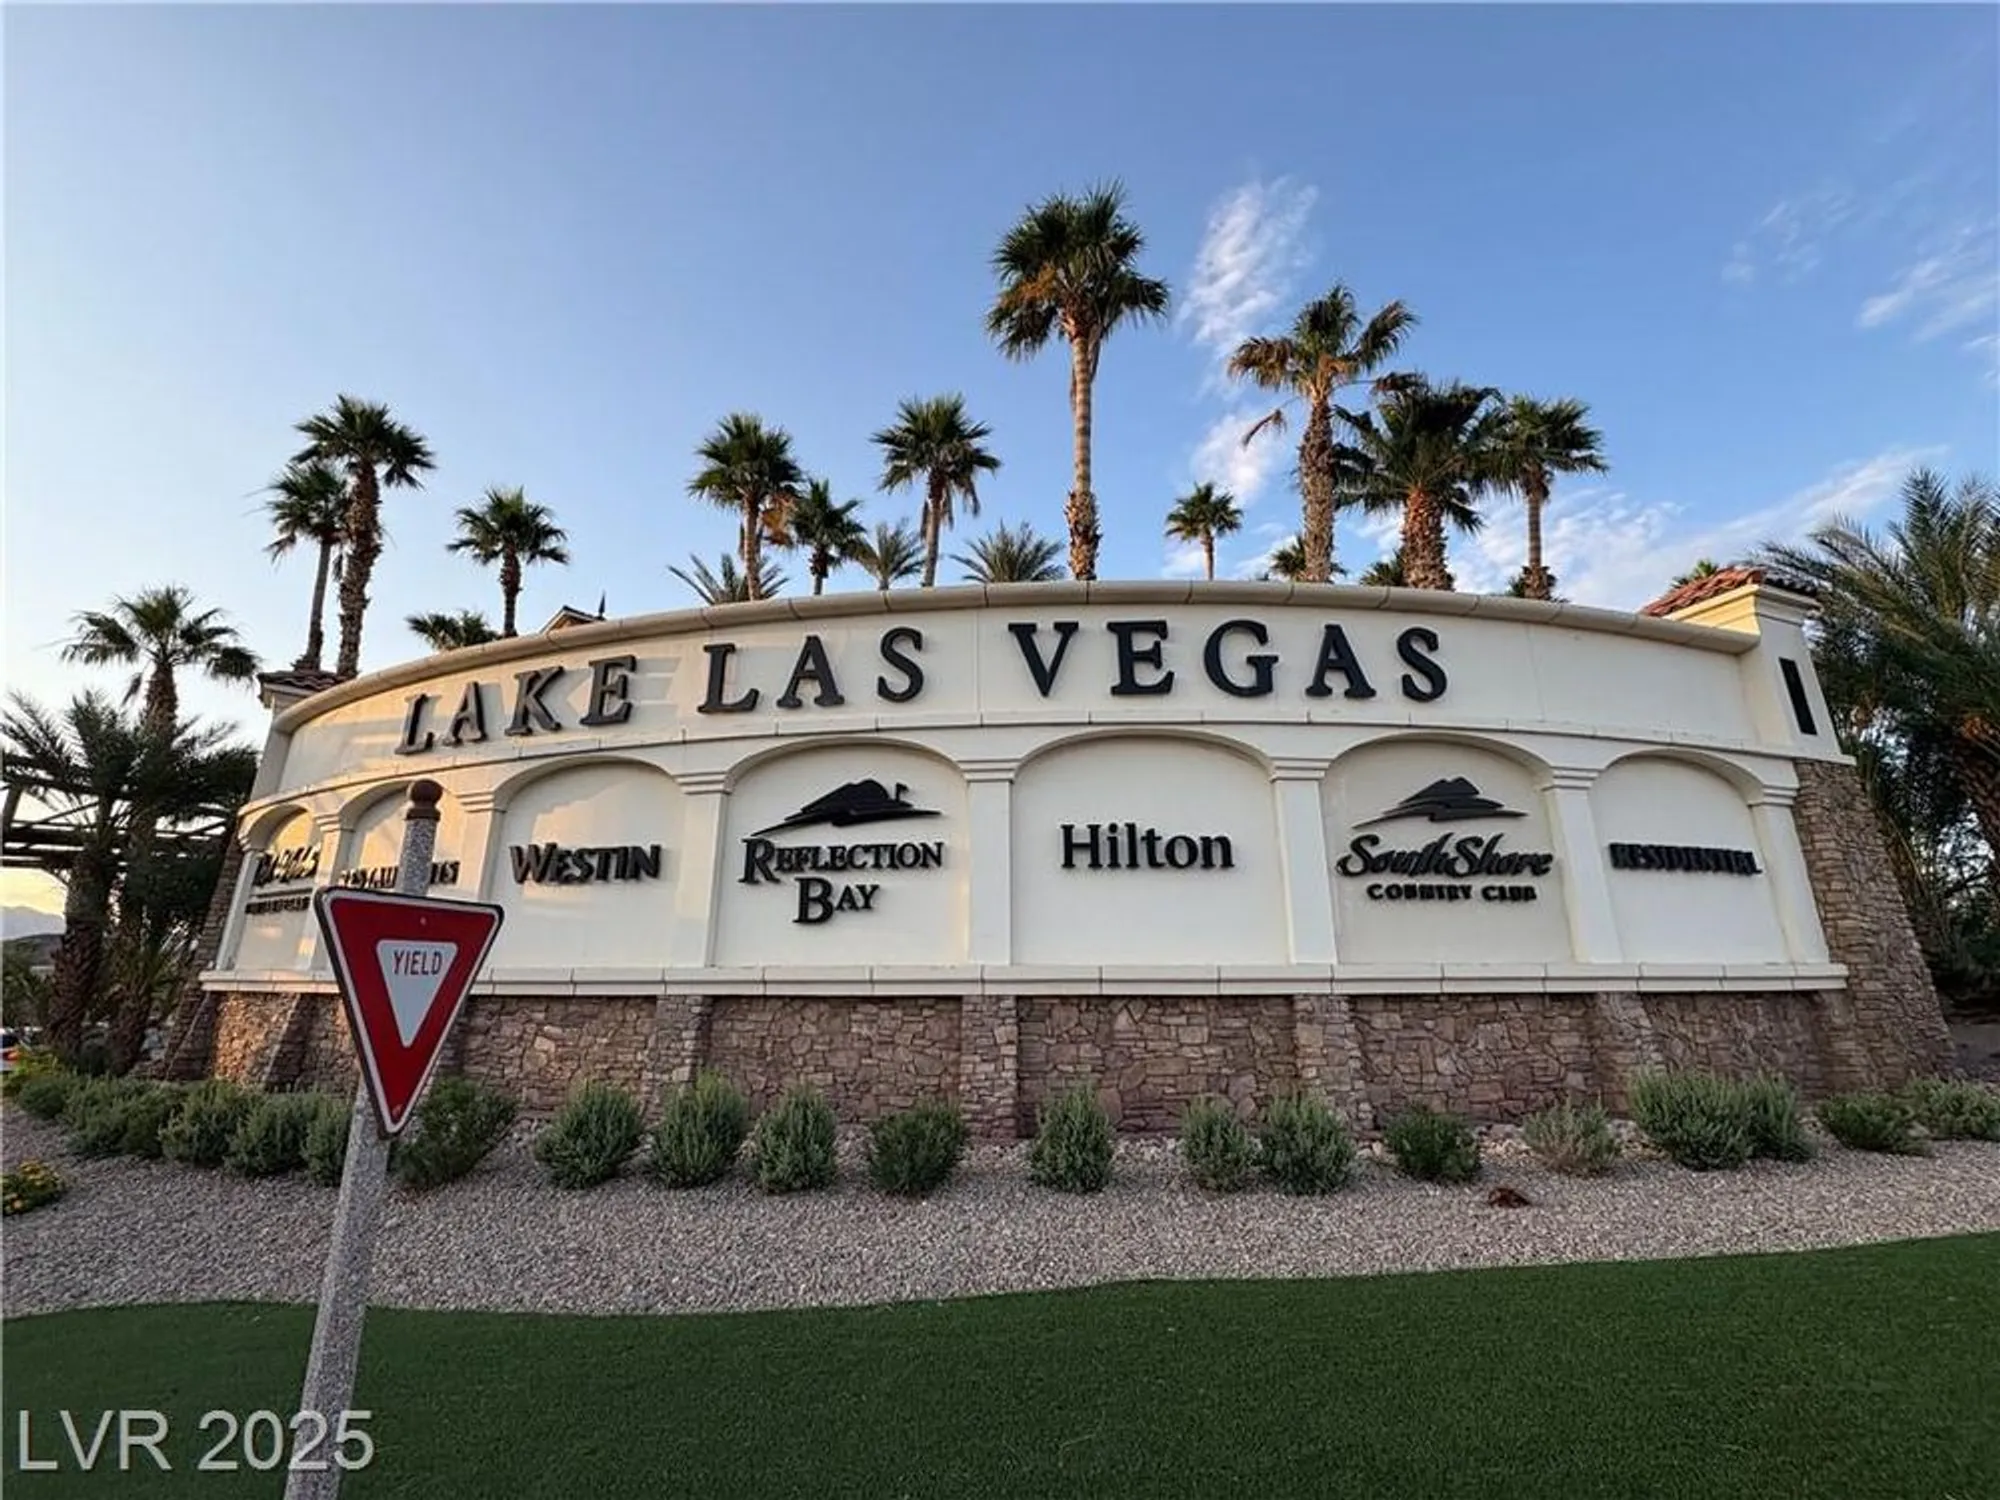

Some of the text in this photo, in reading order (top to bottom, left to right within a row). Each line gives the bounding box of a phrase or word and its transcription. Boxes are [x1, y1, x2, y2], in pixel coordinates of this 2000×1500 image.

[394, 619, 1448, 755] LAKE LAS VEGAS
[509, 842, 662, 884] WESTIN
[738, 837, 944, 884] REFLECTION
[1061, 823, 1235, 870] Hilton
[792, 876, 880, 925] BAY
[1366, 884, 1537, 901] COUNTRY CLUB
[393, 950, 443, 976] YIELD
